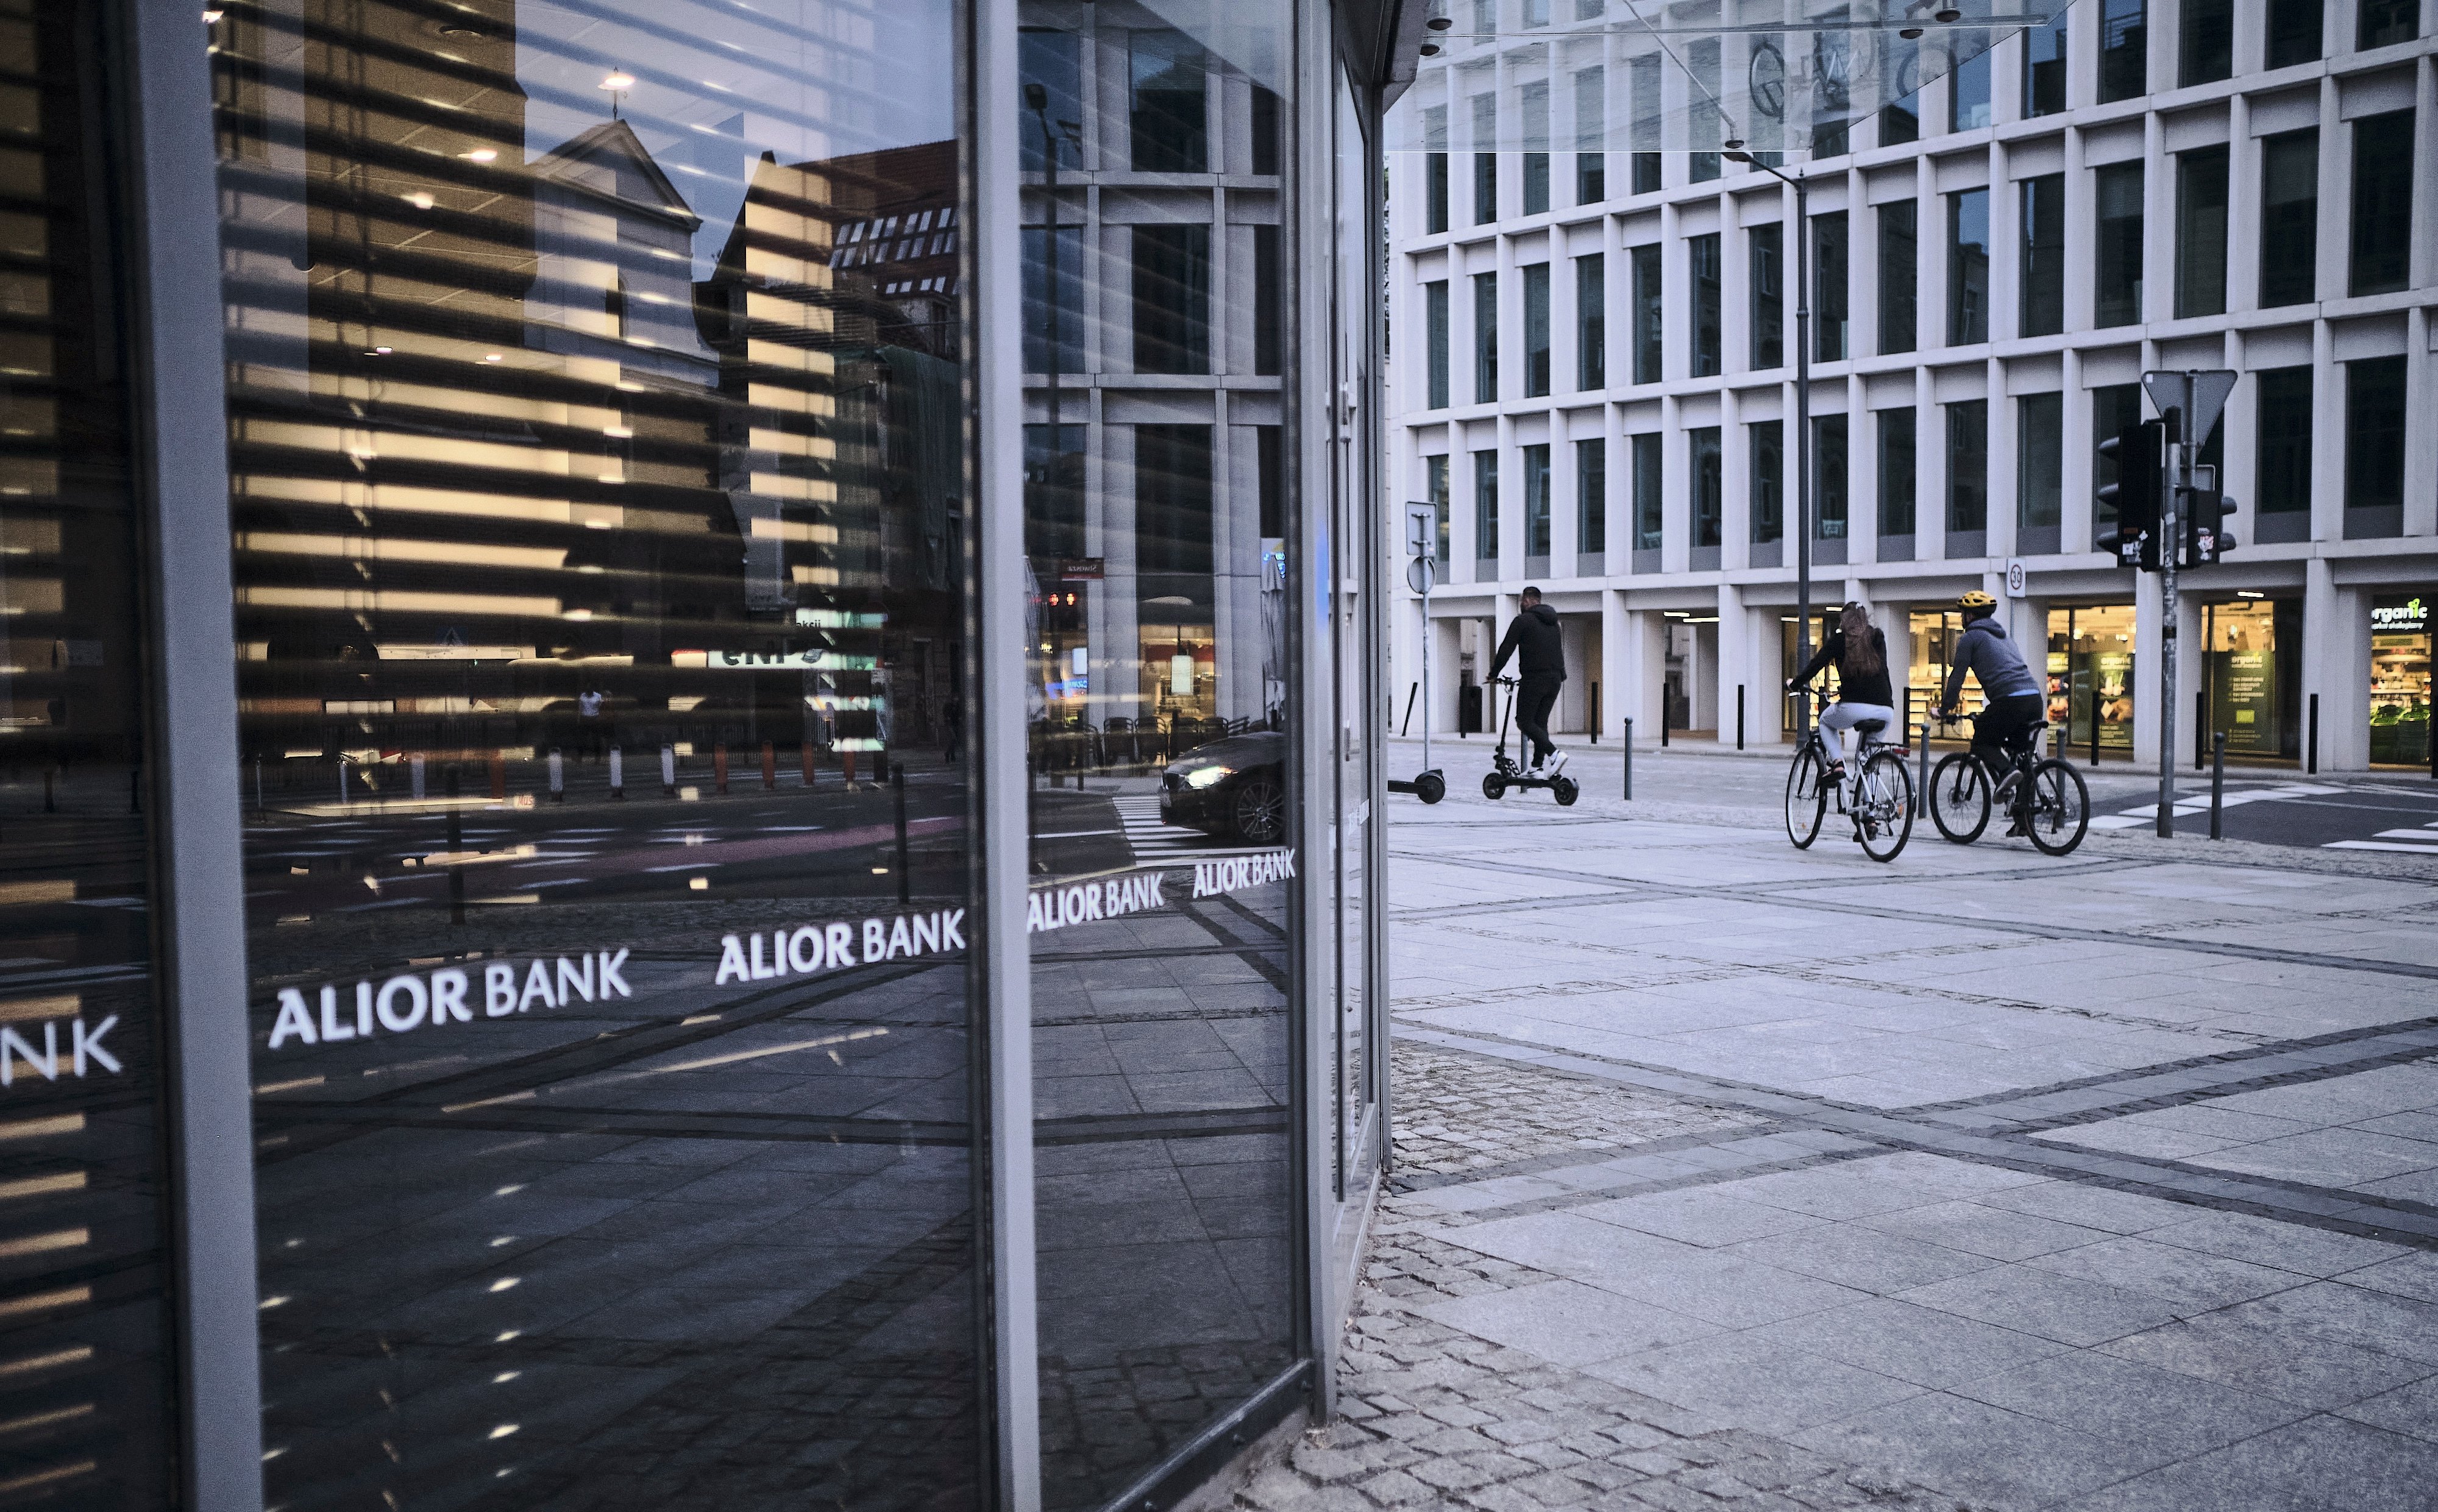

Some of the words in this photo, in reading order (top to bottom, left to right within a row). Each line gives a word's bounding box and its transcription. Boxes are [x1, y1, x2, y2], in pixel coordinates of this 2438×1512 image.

[2012, 571, 2022, 583] 30
[1026, 882, 1103, 934] ALIOR
[1106, 871, 1165, 918] BANK
[1192, 855, 1251, 899] ALIOR
[1252, 848, 1296, 886] BANK
[715, 922, 856, 985] ALIOR
[862, 909, 965, 963] BANK
[268, 969, 472, 1049] ALIOR
[485, 947, 631, 1018] BANK
